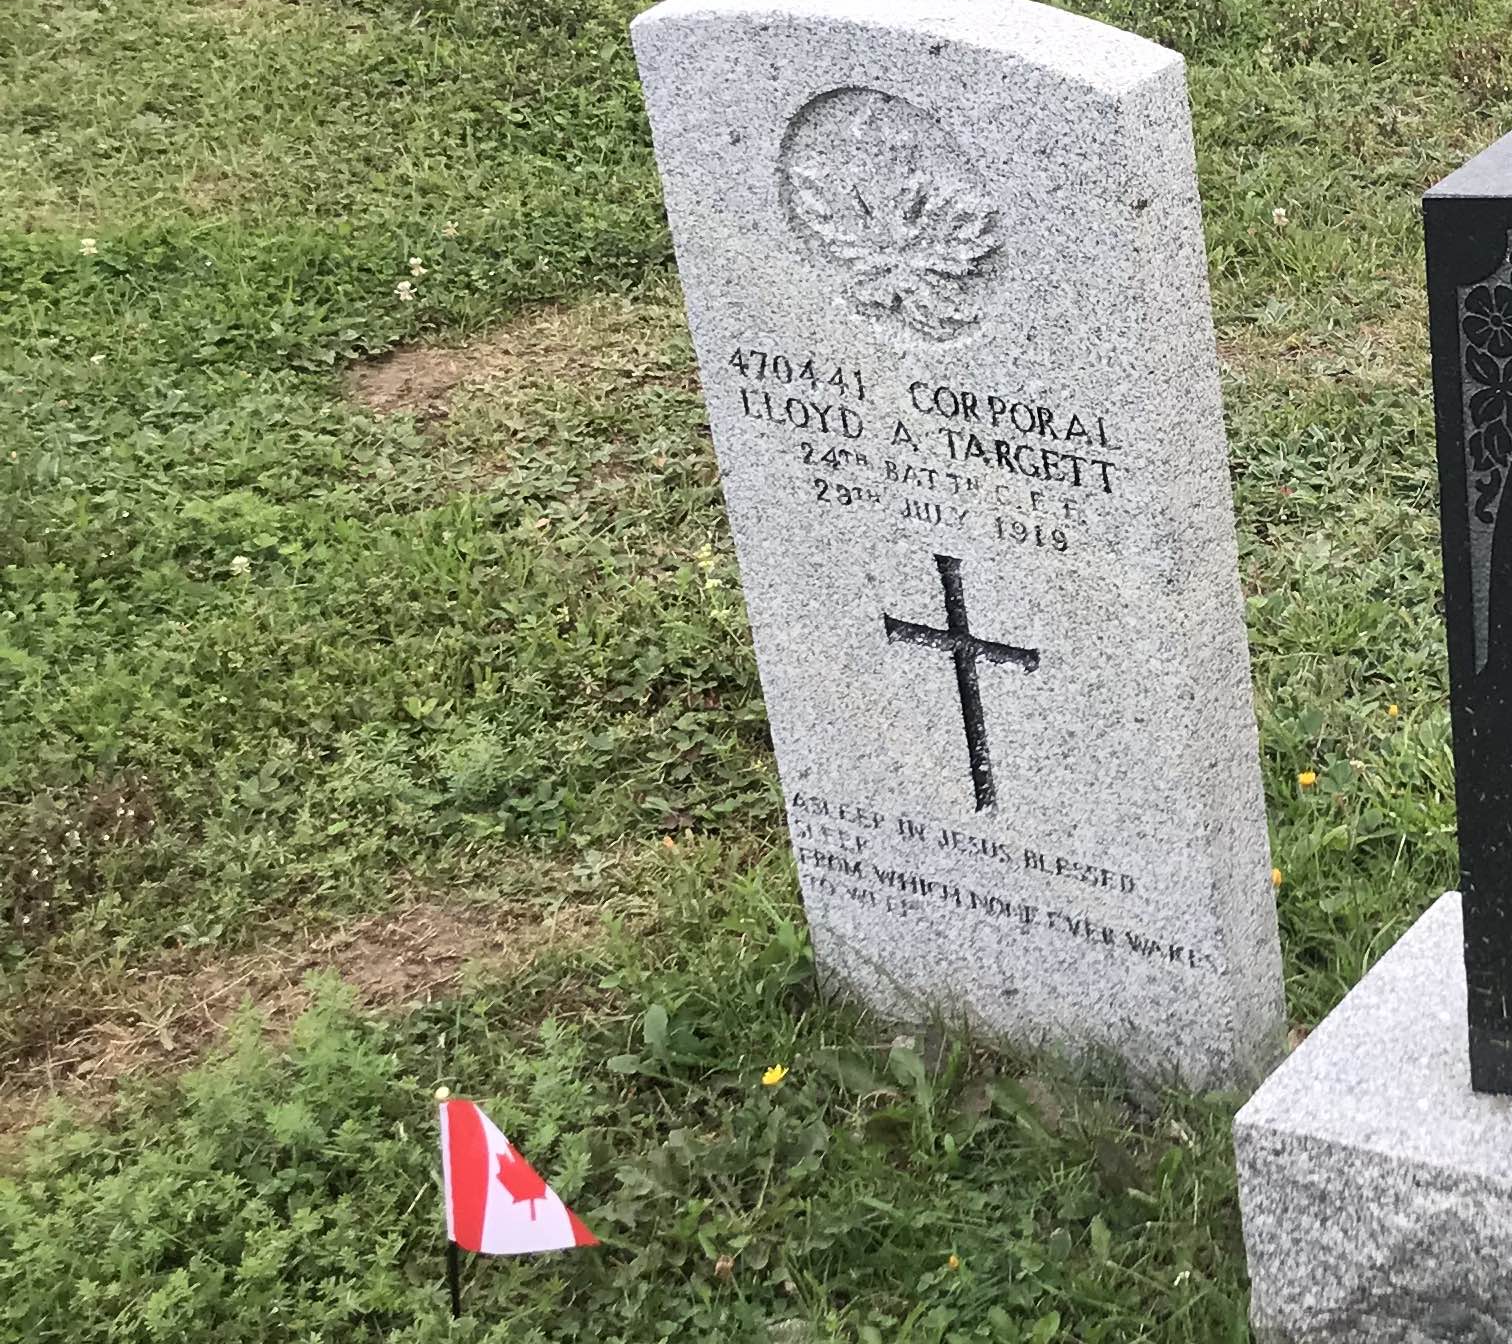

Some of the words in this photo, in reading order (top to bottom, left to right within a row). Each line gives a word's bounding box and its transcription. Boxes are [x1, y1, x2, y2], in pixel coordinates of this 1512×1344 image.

[728, 346, 866, 401] 470441
[909, 380, 1122, 451] CORPORAL
[740, 387, 865, 439] LLOYD
[944, 428, 1117, 494] TARGETT
[997, 517, 1069, 552] 1919
[799, 848, 863, 880] FROM
[874, 867, 963, 908] WHICH
[938, 829, 1012, 863] JESUS
[1024, 848, 1136, 893] BLESSED
